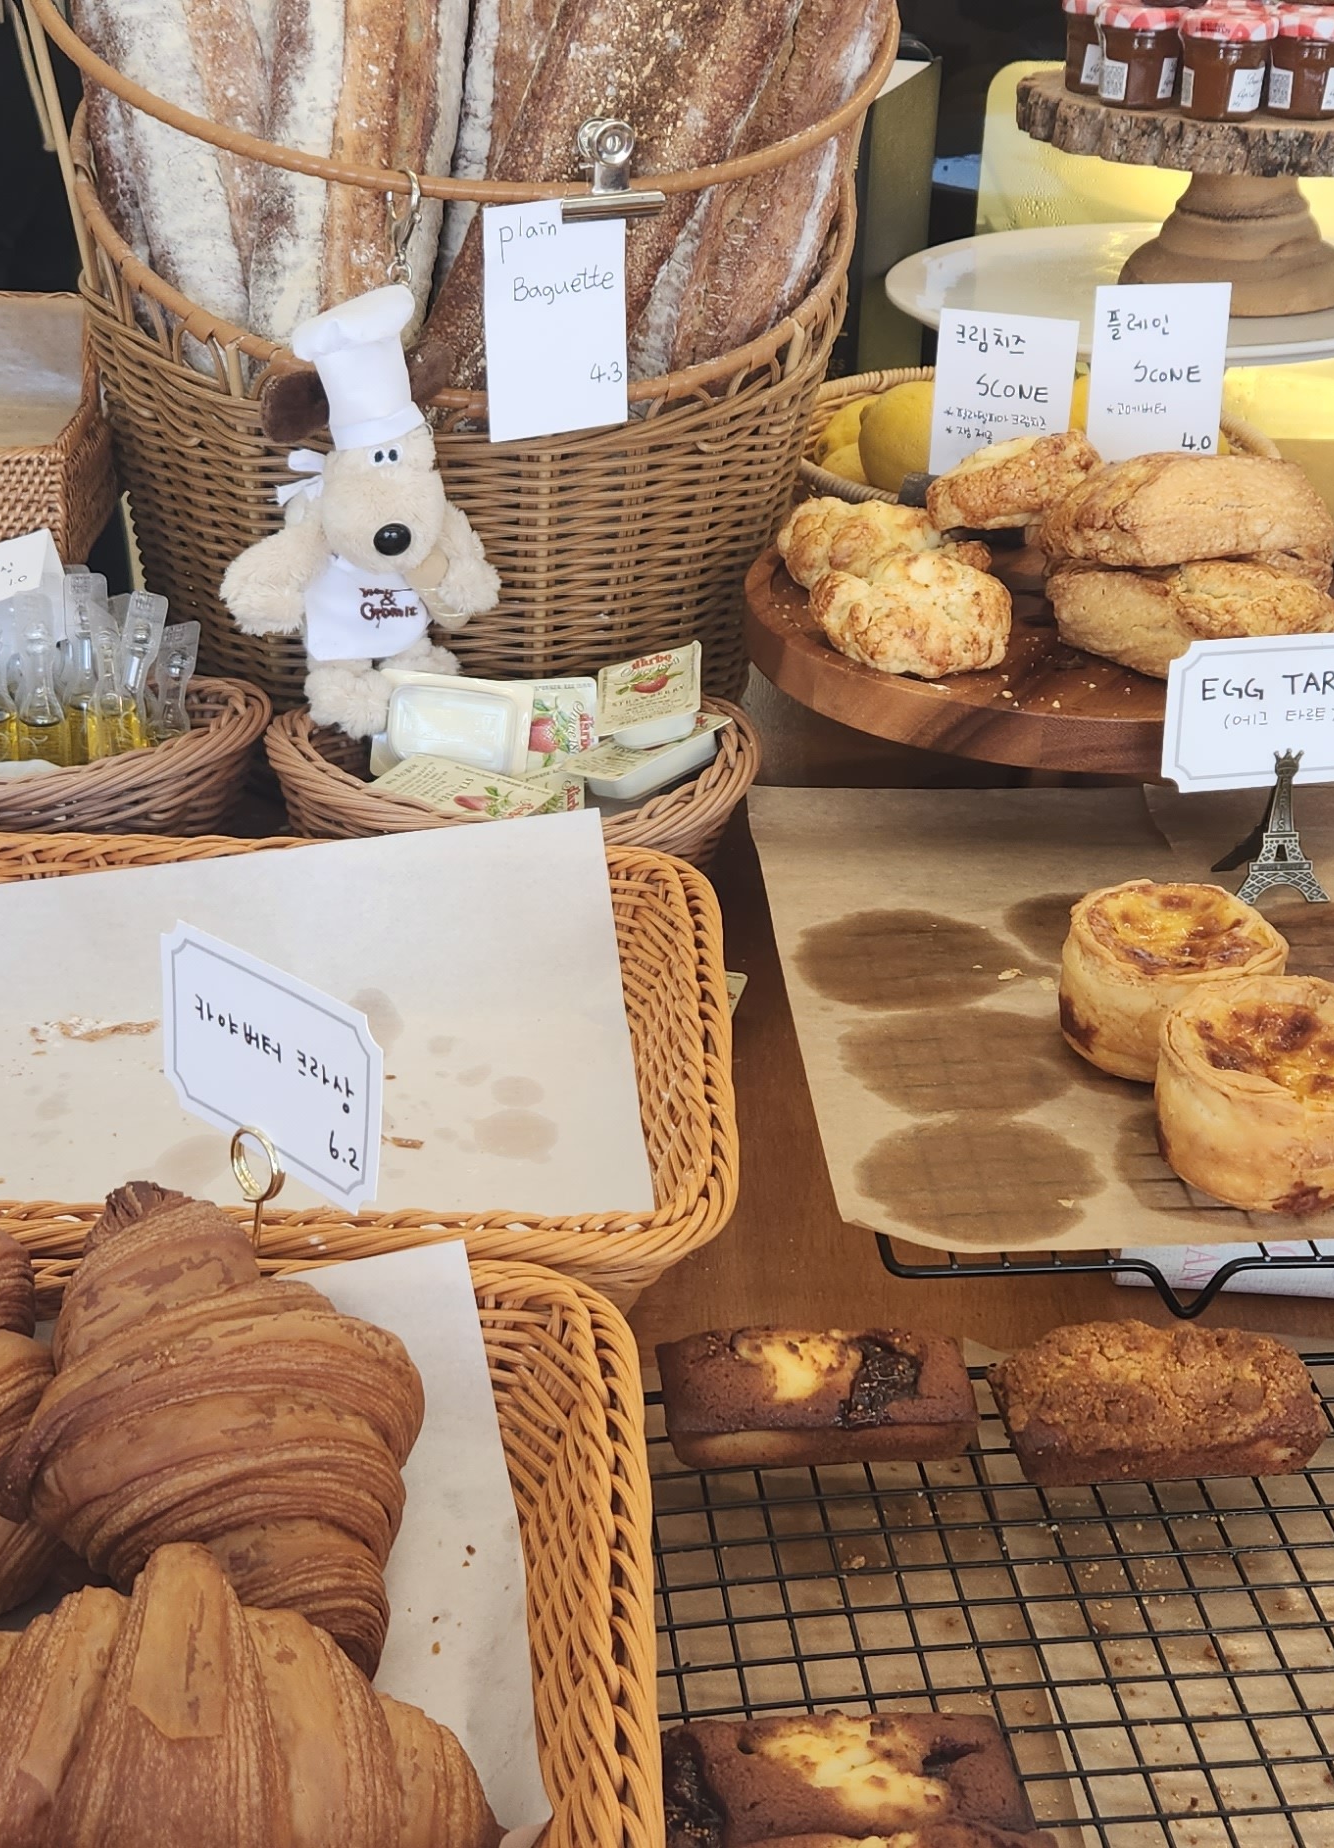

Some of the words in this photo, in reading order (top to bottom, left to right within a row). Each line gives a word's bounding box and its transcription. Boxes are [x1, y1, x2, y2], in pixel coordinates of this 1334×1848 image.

[513, 264, 615, 305] Baguette
[955, 324, 1026, 354] 크림치즈
[1106, 309, 1170, 341] 플레인
[589, 361, 623, 383] 4.3
[975, 373, 1050, 404] SCONE
[1181, 431, 1212, 452] 4.0
[1201, 677, 1265, 701] EGG
[194, 993, 282, 1063] 카야버터
[296, 1049, 355, 1115] 크라상
[328, 1129, 360, 1172] 6.2
